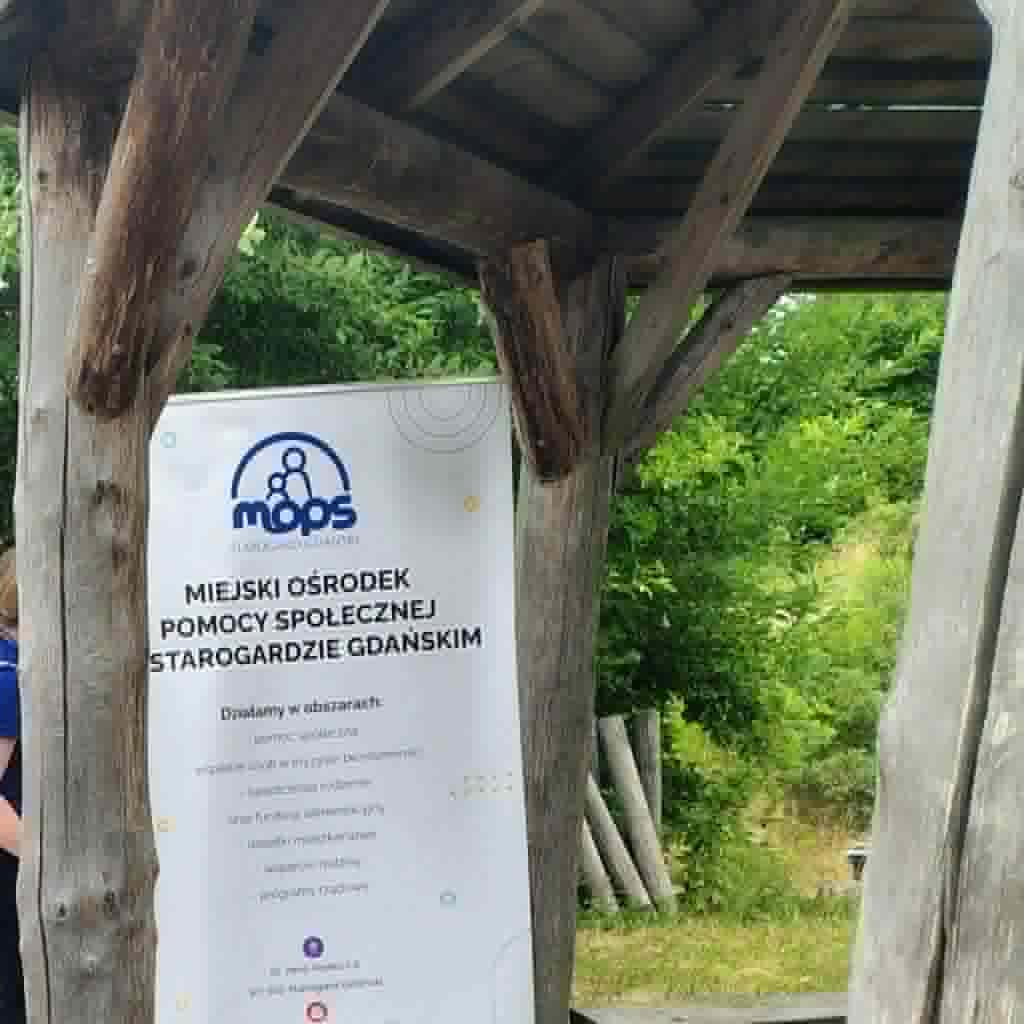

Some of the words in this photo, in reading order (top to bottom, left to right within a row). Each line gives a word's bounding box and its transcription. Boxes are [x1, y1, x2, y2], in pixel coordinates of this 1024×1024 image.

[184, 578, 280, 606] MIEJSKI
[288, 568, 410, 597] OŚRODEK
[160, 611, 269, 639] POMOCY
[276, 599, 436, 632] SPOŁECZNEJ
[150, 640, 340, 672] STAROGARDZIE
[347, 626, 482, 657] GDAŃSKIM
